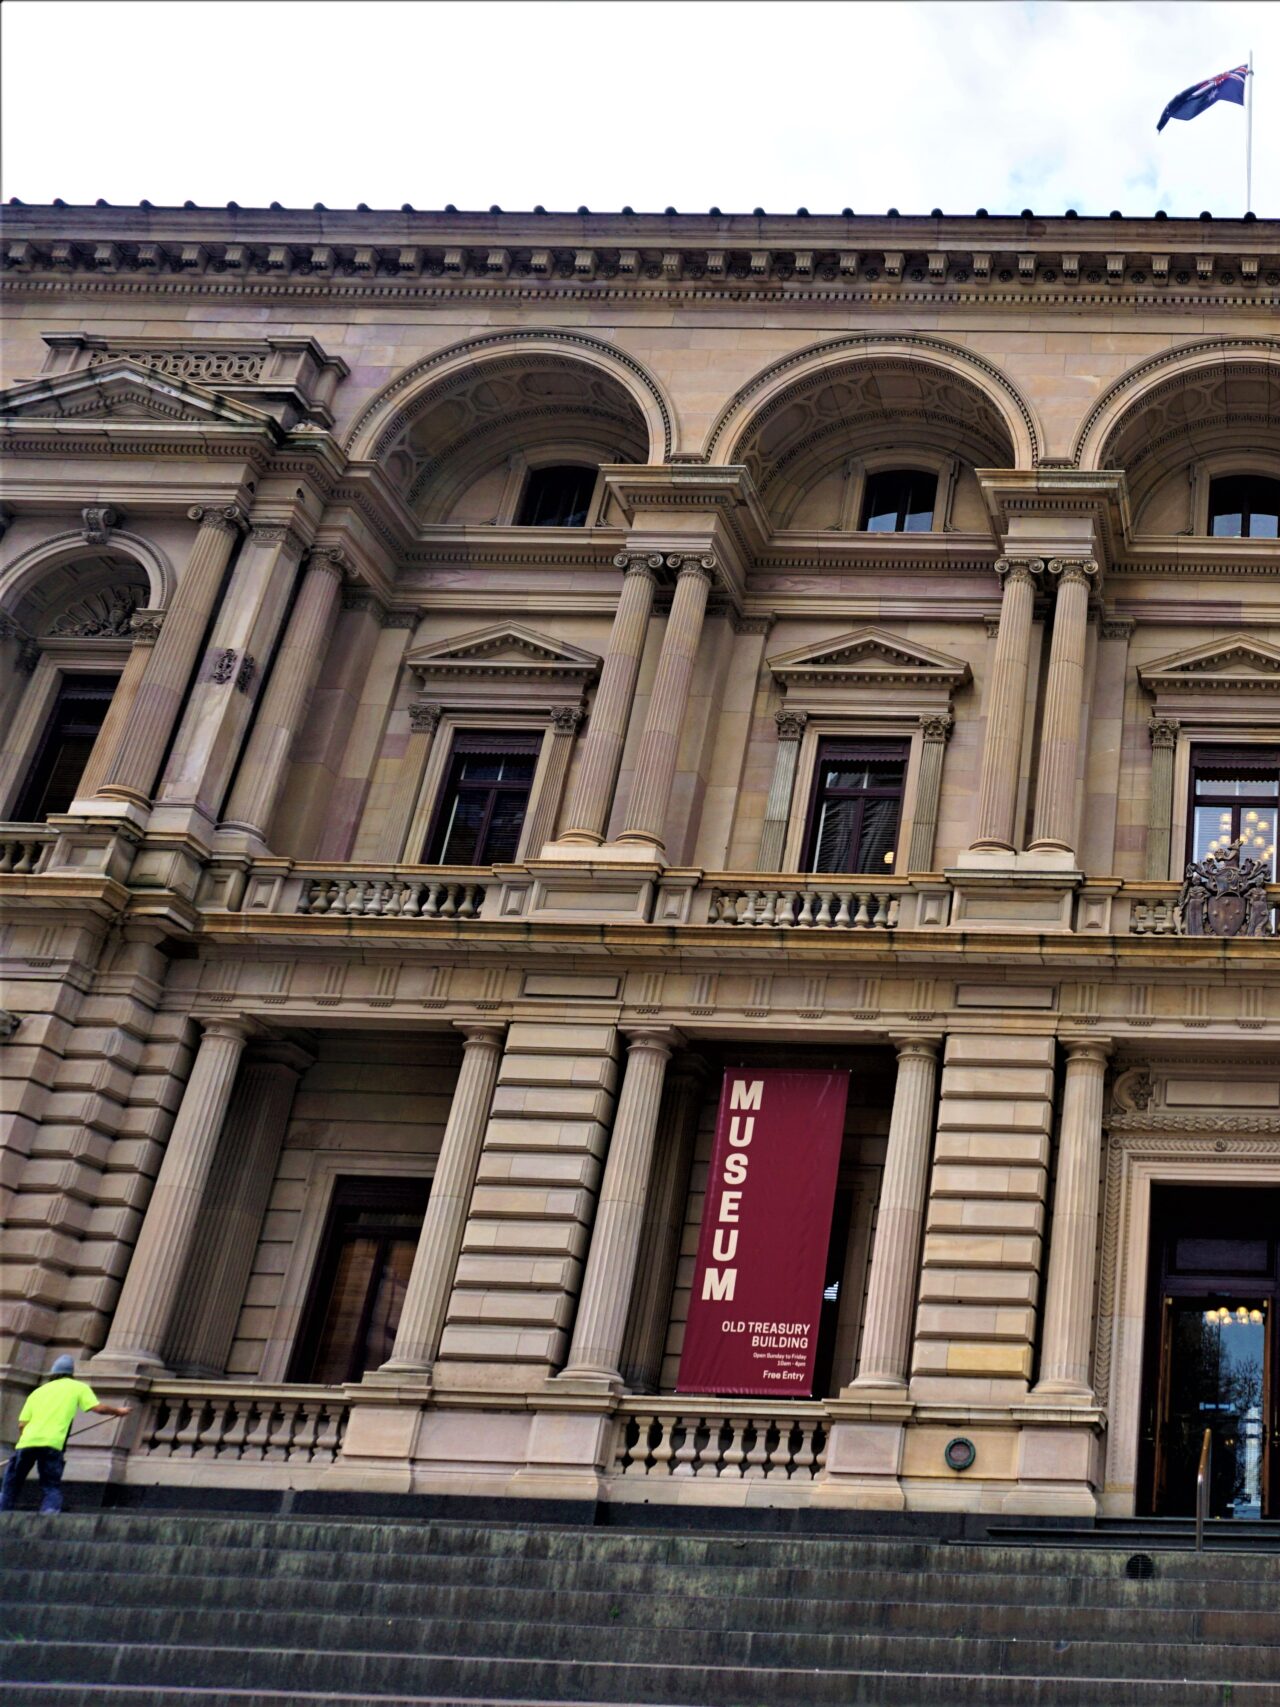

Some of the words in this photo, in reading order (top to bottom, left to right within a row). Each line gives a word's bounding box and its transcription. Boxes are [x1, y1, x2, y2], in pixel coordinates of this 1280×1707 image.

[701, 1079, 764, 1301] MUSEUM
[721, 1320, 746, 1333] OLD
[748, 1321, 811, 1335] TREASURY
[751, 1335, 809, 1349] BUILDING
[762, 1369, 781, 1379] Free
[782, 1370, 805, 1382] Entry
